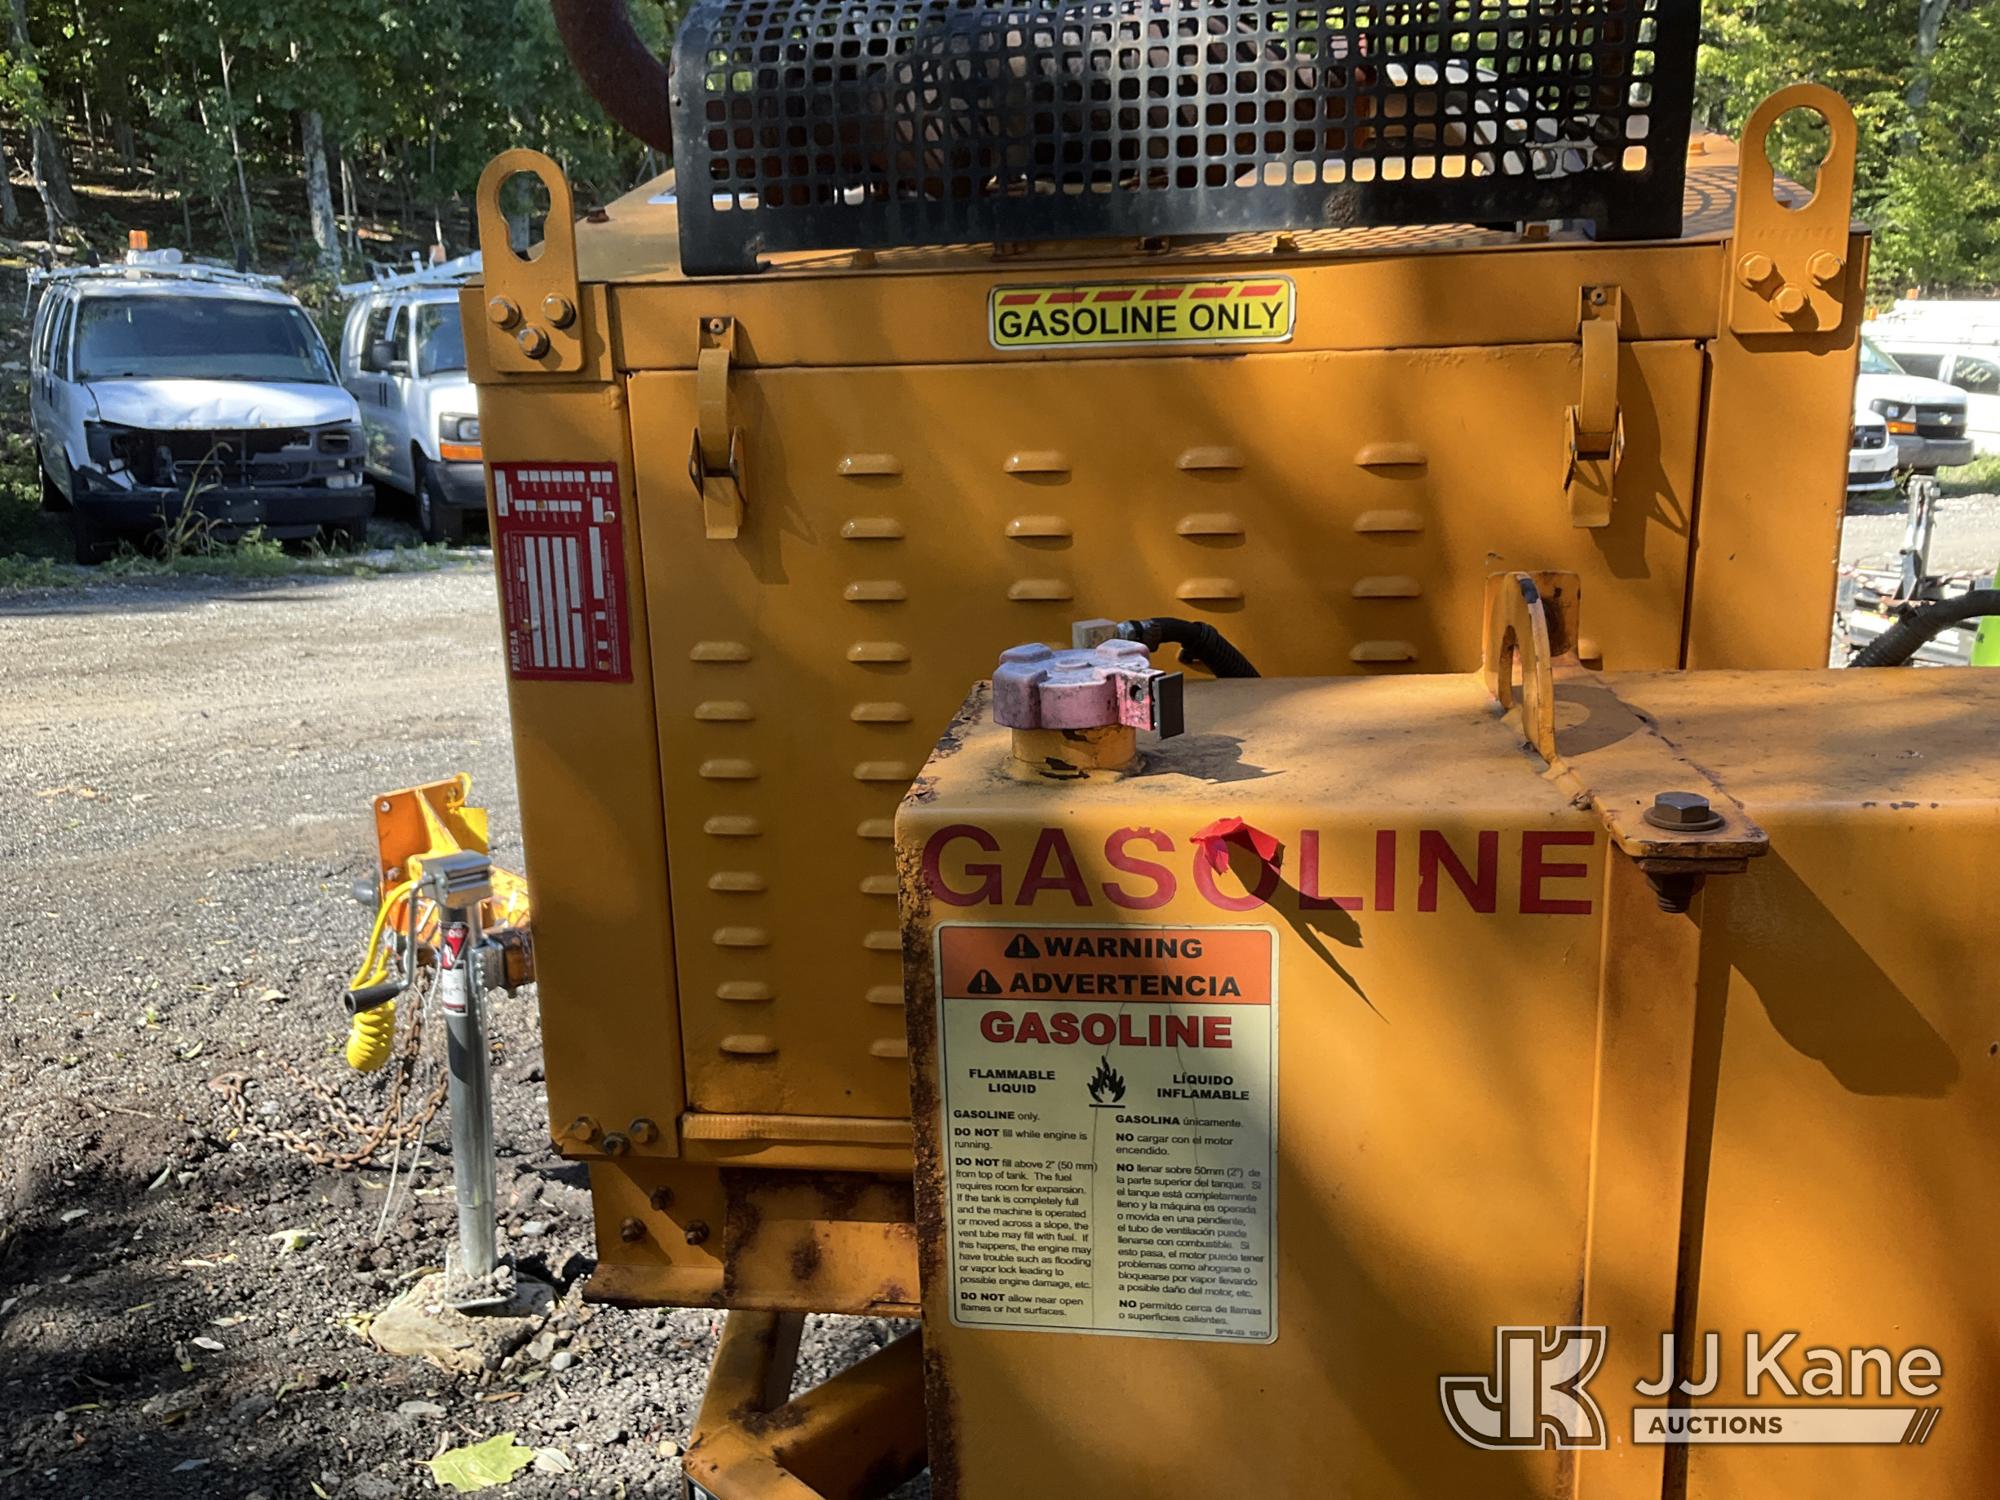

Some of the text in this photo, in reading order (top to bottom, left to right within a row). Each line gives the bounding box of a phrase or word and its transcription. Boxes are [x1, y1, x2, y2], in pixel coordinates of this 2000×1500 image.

[998, 301, 1283, 338] GASOLINE ONLY
[921, 823, 1593, 915] GASOLINE
[1044, 936, 1203, 959] WARNING
[1009, 972, 1241, 997] ADVERTENCIA
[980, 1010, 1233, 1049] GASOLINE
[969, 1068, 1056, 1081] FLAMMABLE
[988, 1082, 1036, 1095] LIQUID
[1157, 1088, 1250, 1100] INFLAMABLE
[953, 1109, 1040, 1122] GASOLINE only.
[1115, 1114, 1180, 1125] GASOLINA
[954, 1127, 1087, 1141] DO NOT fill while engine is
[1115, 1132, 1133, 1141] NO
[954, 1139, 992, 1150] running.
[955, 1157, 971, 1165] DO
[975, 1158, 999, 1166] NOT
[1002, 1159, 1012, 1167] fill
[1014, 1159, 1042, 1168] above
[1057, 1161, 1073, 1171] (50
[1075, 1163, 1097, 1172] mm)
[1116, 1163, 1133, 1171] NO
[956, 1169, 1071, 1181] from top of tank. The fuel
[956, 1181, 992, 1192] requires
[956, 1193, 962, 1201] If
[980, 1194, 1000, 1202] tank
[1002, 1195, 1010, 1203] is
[1012, 1195, 1062, 1206] completely
[1065, 1197, 1078, 1205] full
[957, 1205, 1086, 1219] and the machine is operated
[969, 1217, 999, 1226] moved
[1043, 1220, 1071, 1231] slope,
[1074, 1221, 1088, 1229] the
[957, 1229, 1088, 1241] vent tube may fill with fuel. If
[958, 1241, 1091, 1255] this happens, the engine may
[958, 1252, 980, 1260] have
[982, 1253, 1014, 1261] trouble
[1016, 1254, 1038, 1262] such
[1054, 1256, 1091, 1266] flooding
[970, 1266, 995, 1274] vapor
[998, 1265, 1016, 1273] lock
[1018, 1266, 1052, 1276] leading
[1054, 1267, 1064, 1275] to
[959, 1276, 996, 1286] possible
[998, 1277, 1032, 1287] engine
[1032, 1278, 1072, 1289] damage,
[960, 1292, 977, 1300] DO
[980, 1293, 1005, 1301] NOT
[1007, 1294, 1032, 1302] allow
[1059, 1297, 1083, 1306] open
[1119, 1300, 1136, 1308] NO
[960, 1303, 991, 1312] flames
[1005, 1305, 1021, 1313] hot
[1023, 1306, 1066, 1315] surfaces.
